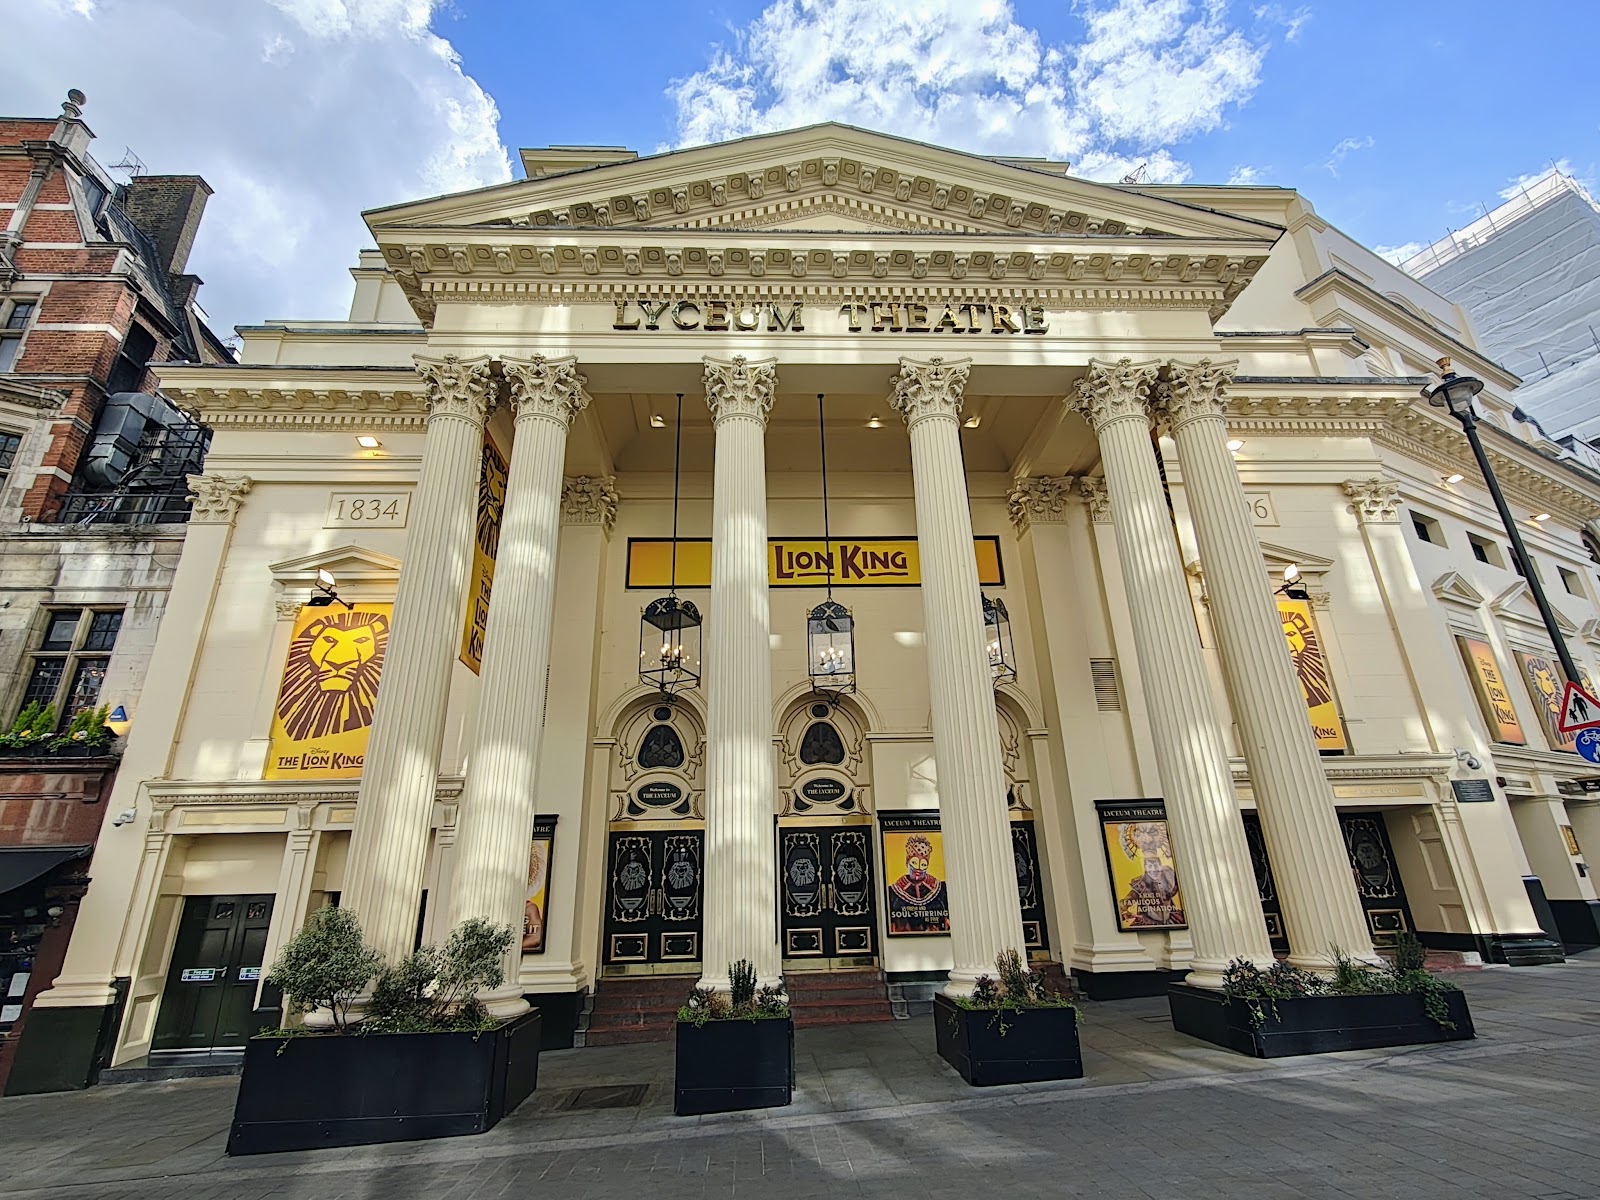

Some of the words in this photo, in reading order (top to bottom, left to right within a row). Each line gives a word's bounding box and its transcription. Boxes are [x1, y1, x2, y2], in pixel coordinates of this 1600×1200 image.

[613, 300, 804, 331] LYCEUM
[839, 302, 1049, 334] THEATRE
[335, 499, 398, 520] 1834
[774, 545, 834, 579] LION
[840, 545, 907, 580] KING
[1486, 682, 1504, 702] LION
[1492, 703, 1515, 724] KING
[1311, 725, 1337, 739] KING
[278, 757, 299, 767] THE
[300, 753, 329, 770] LION
[330, 752, 364, 769] KING
[891, 909, 949, 918] SOUL-STIRRING
[528, 924, 539, 934] IT
